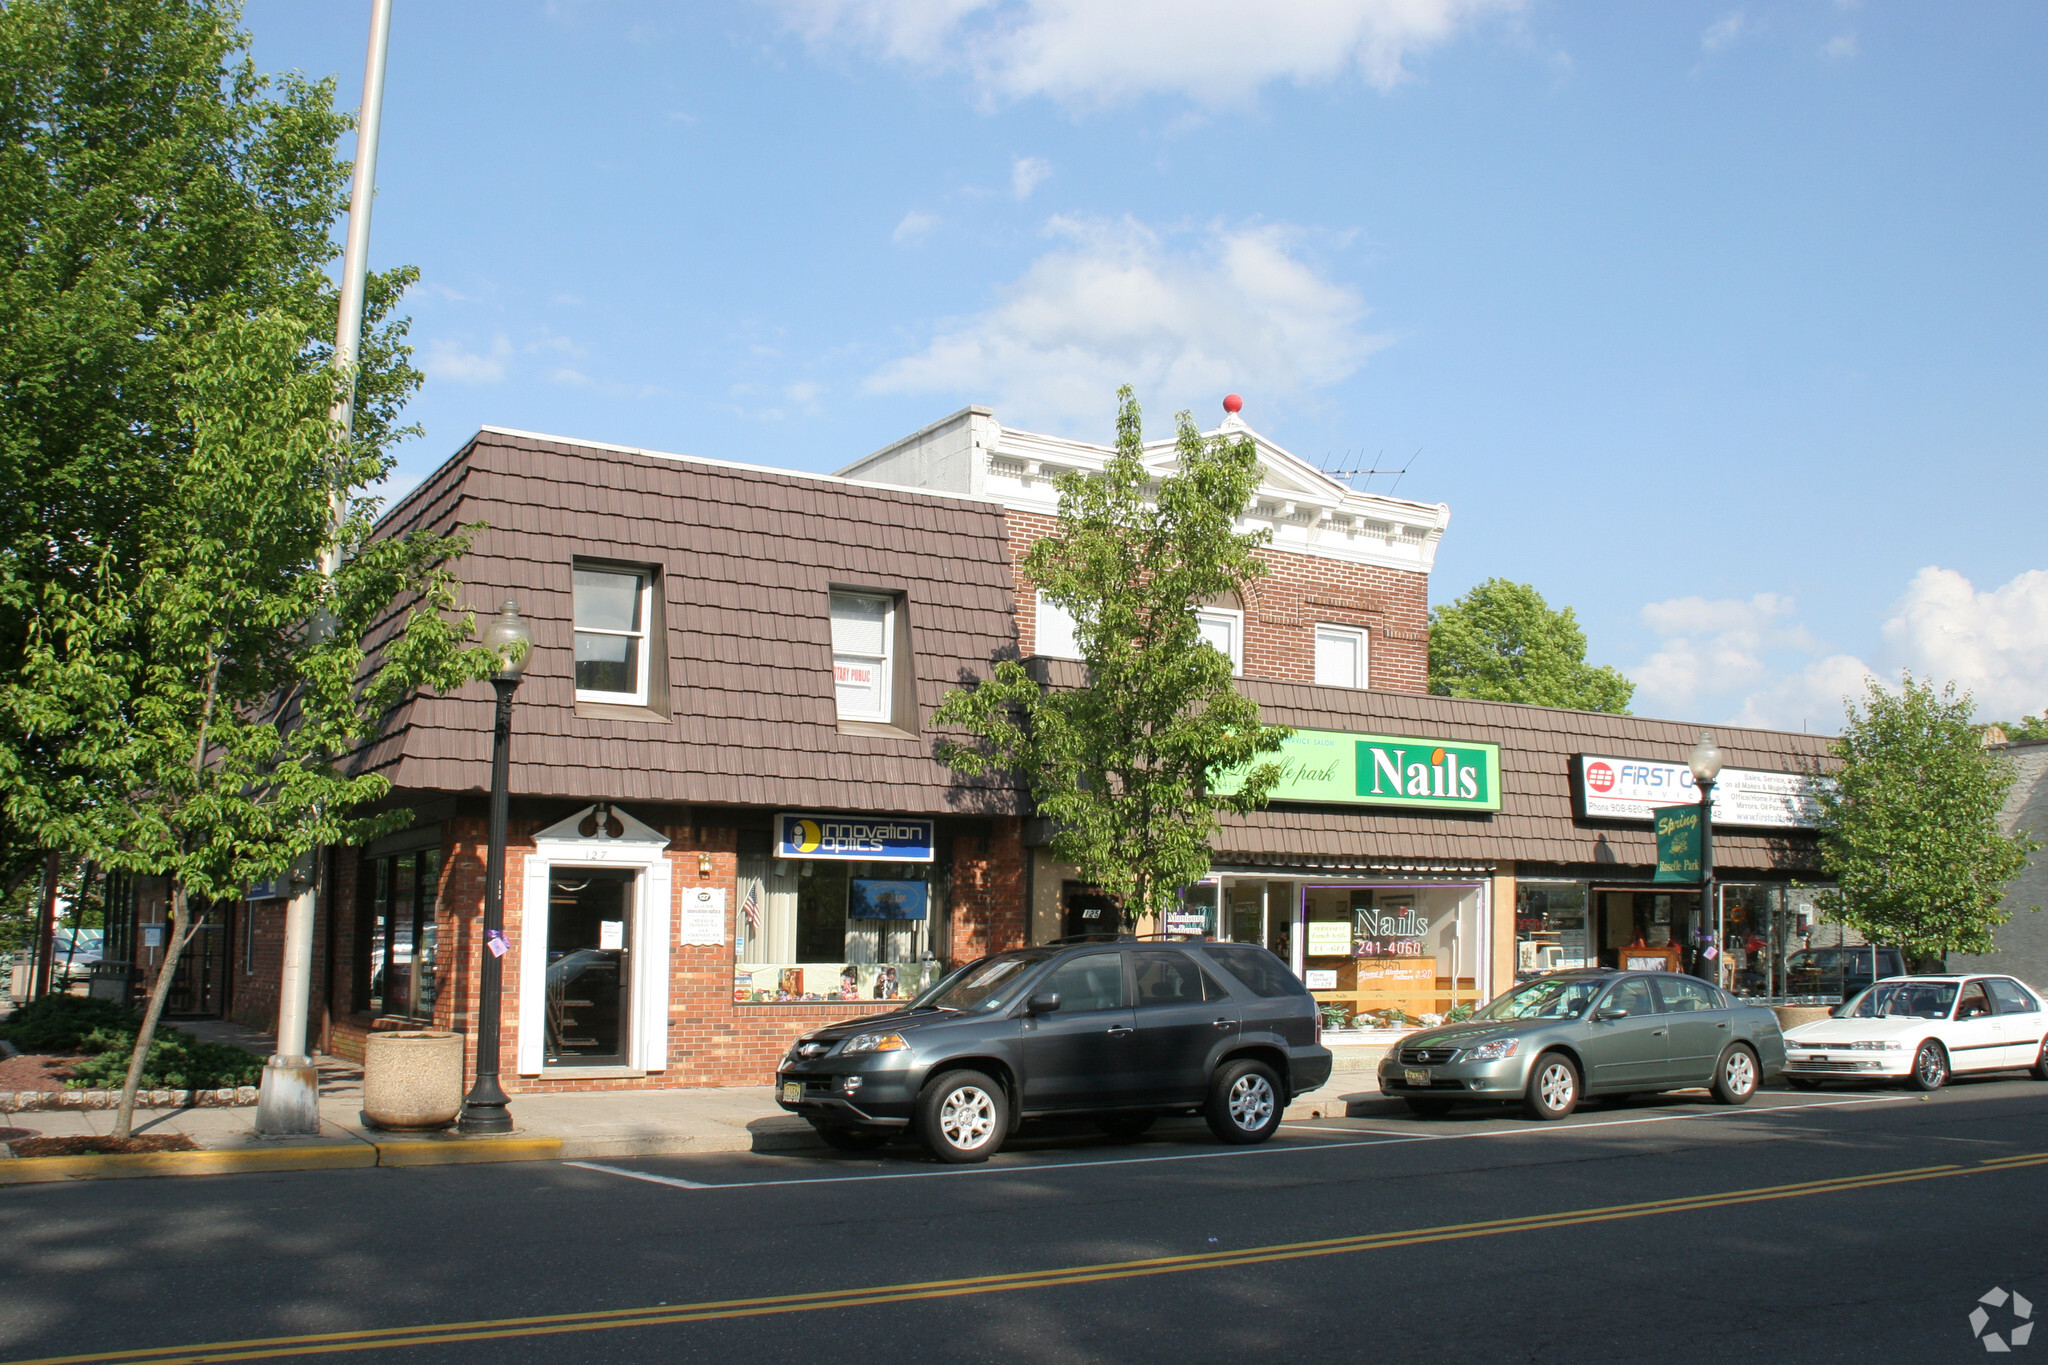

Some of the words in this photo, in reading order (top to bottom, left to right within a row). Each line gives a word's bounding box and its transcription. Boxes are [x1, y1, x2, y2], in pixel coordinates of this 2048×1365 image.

[832, 666, 849, 682] OTARY
[851, 668, 870, 683] PUBLIC
[1314, 739, 1335, 747] SALON
[1292, 759, 1340, 787] park
[1369, 747, 1478, 800] Nails
[1618, 789, 1720, 801] SERVICS
[1588, 802, 1609, 811] Phone
[1611, 803, 1653, 814] 908-620-12
[822, 823, 922, 840] innovation
[1658, 814, 1698, 836] Spring
[821, 836, 883, 853] optics
[585, 850, 608, 860] 127
[1659, 860, 1682, 872] Roselle
[1684, 859, 1700, 871] Park
[1085, 910, 1100, 918] 125
[1354, 907, 1428, 937] Nails
[1358, 941, 1421, 954] 241-4060
